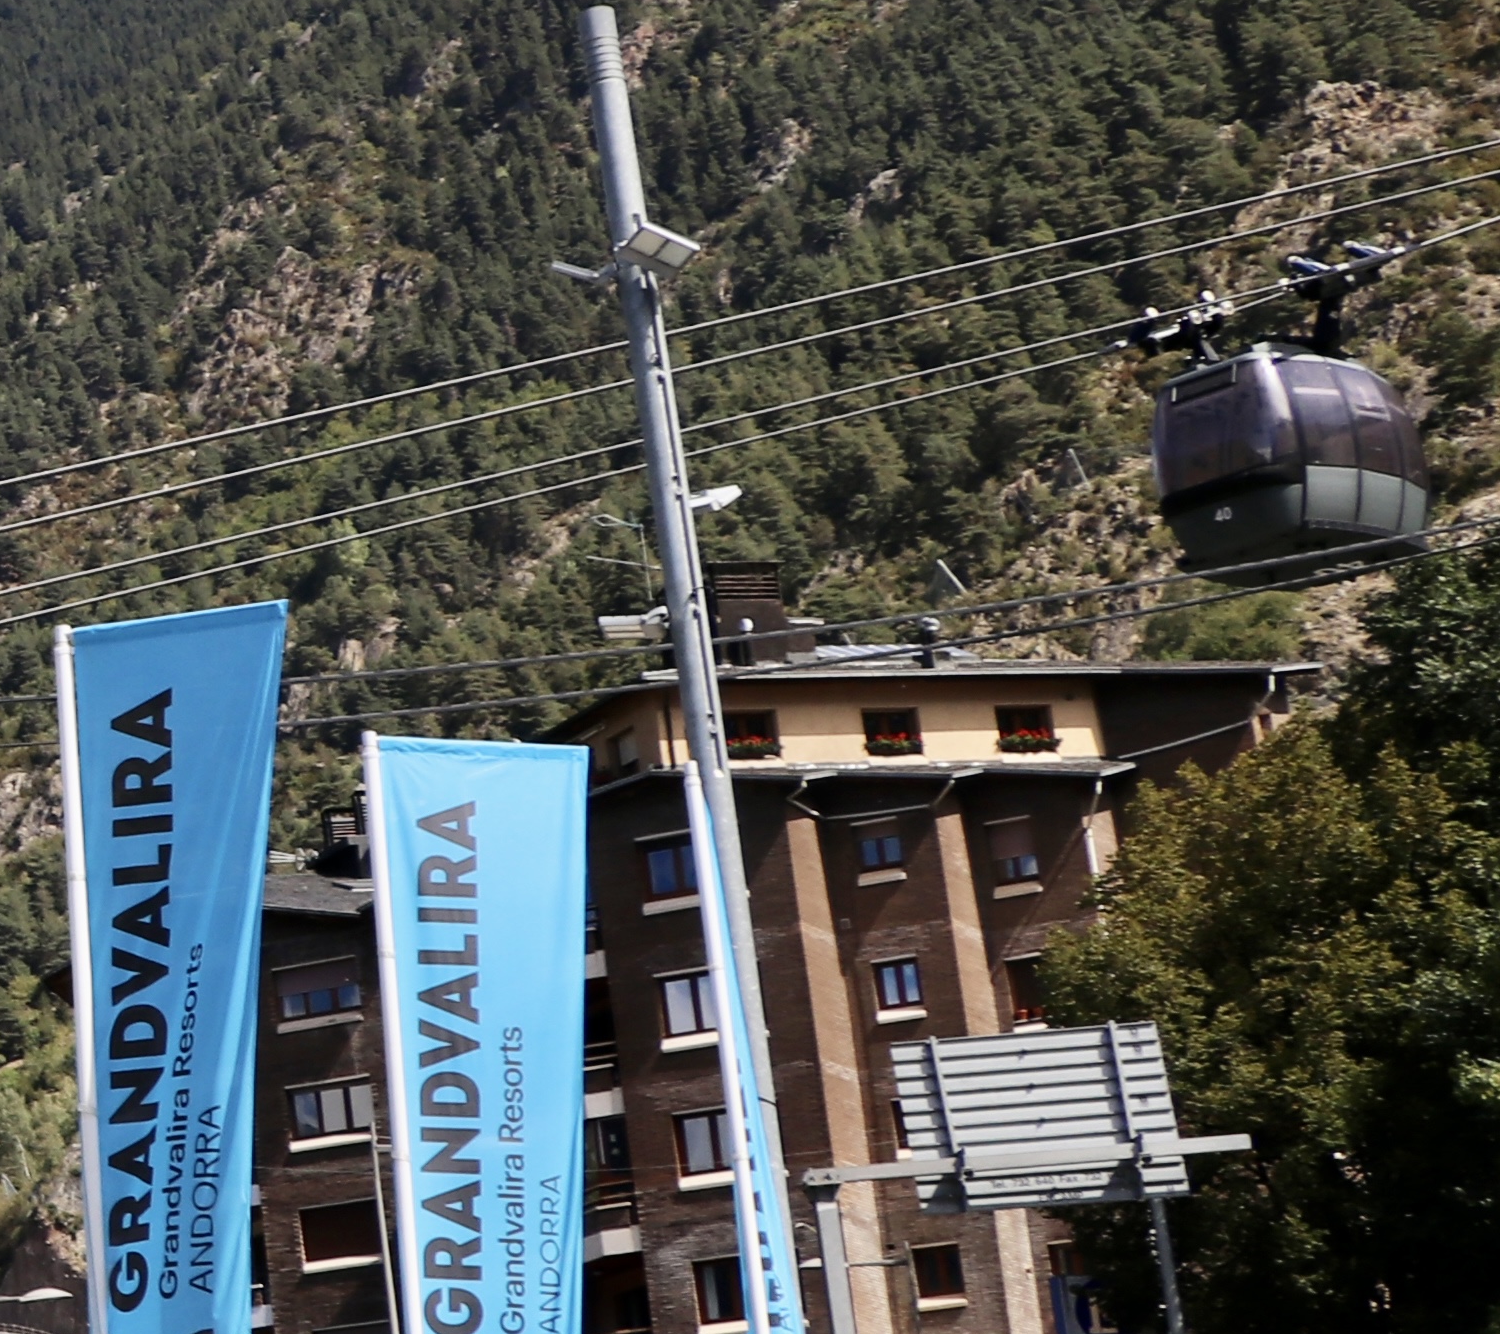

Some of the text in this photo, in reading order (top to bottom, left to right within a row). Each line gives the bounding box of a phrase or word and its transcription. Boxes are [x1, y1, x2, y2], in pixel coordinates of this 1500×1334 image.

[1214, 507, 1232, 521] 40
[108, 687, 173, 1313] GRANDVALIRA
[498, 1025, 525, 1143] Resorts
[158, 943, 204, 1300] Grandvalira Resorts
[189, 1104, 222, 1295] ANDORRA
[538, 1174, 562, 1334] ANDORRA
